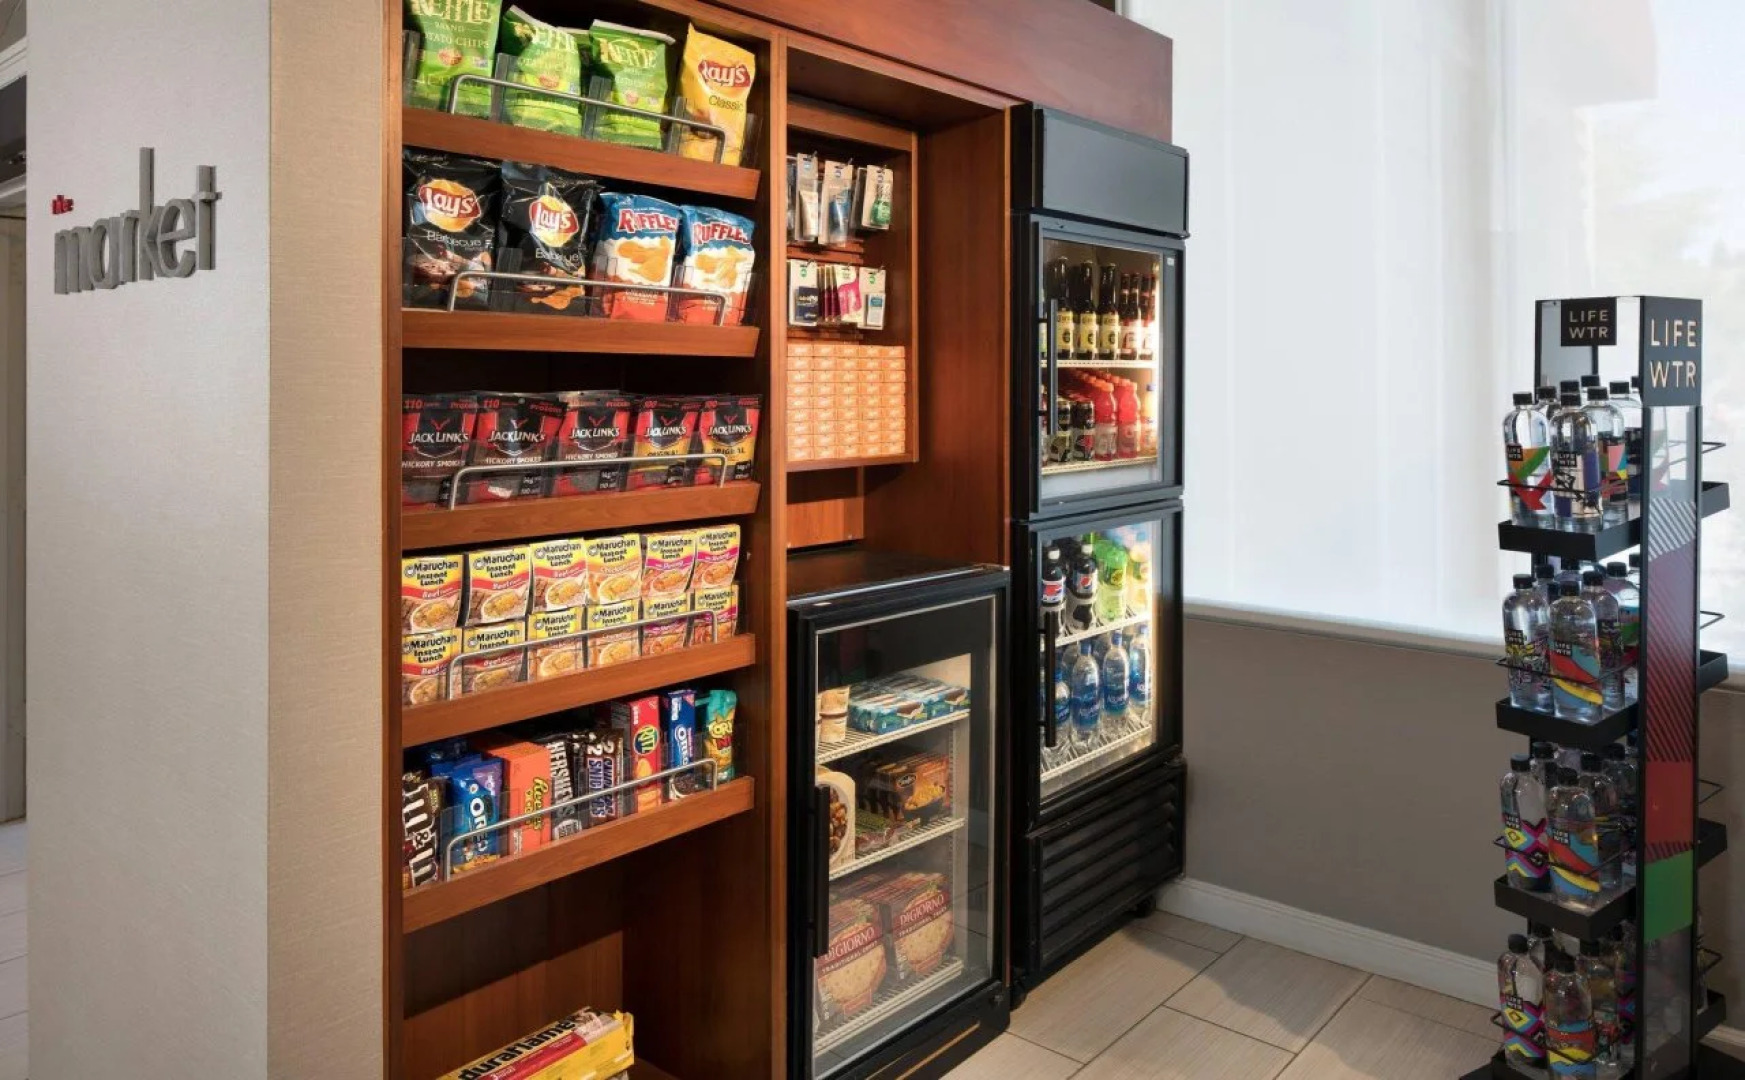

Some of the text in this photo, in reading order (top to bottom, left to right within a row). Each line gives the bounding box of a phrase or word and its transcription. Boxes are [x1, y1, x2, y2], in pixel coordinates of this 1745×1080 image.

[700, 61, 746, 87] Lay's
[708, 95, 744, 112] Classic
[426, 188, 476, 218] Lay's
[54, 147, 222, 295] market
[535, 204, 571, 231] Lay's
[1569, 310, 1609, 323] LIFE
[1569, 326, 1609, 338] WTR
[1651, 319, 1697, 347] LIFE
[1650, 361, 1697, 389] WTR
[705, 531, 737, 541] Maruchan
[542, 544, 581, 553] Maruchan
[596, 538, 636, 550] Maruchan
[658, 538, 692, 548] Maruchan
[483, 552, 526, 564] Maruchan
[414, 560, 459, 572] Maruchan
[599, 605, 634, 617] Maruchan
[410, 634, 457, 648] Maruchan
[476, 629, 520, 642] Maruchan
[458, 1018, 576, 1080] duraflame
